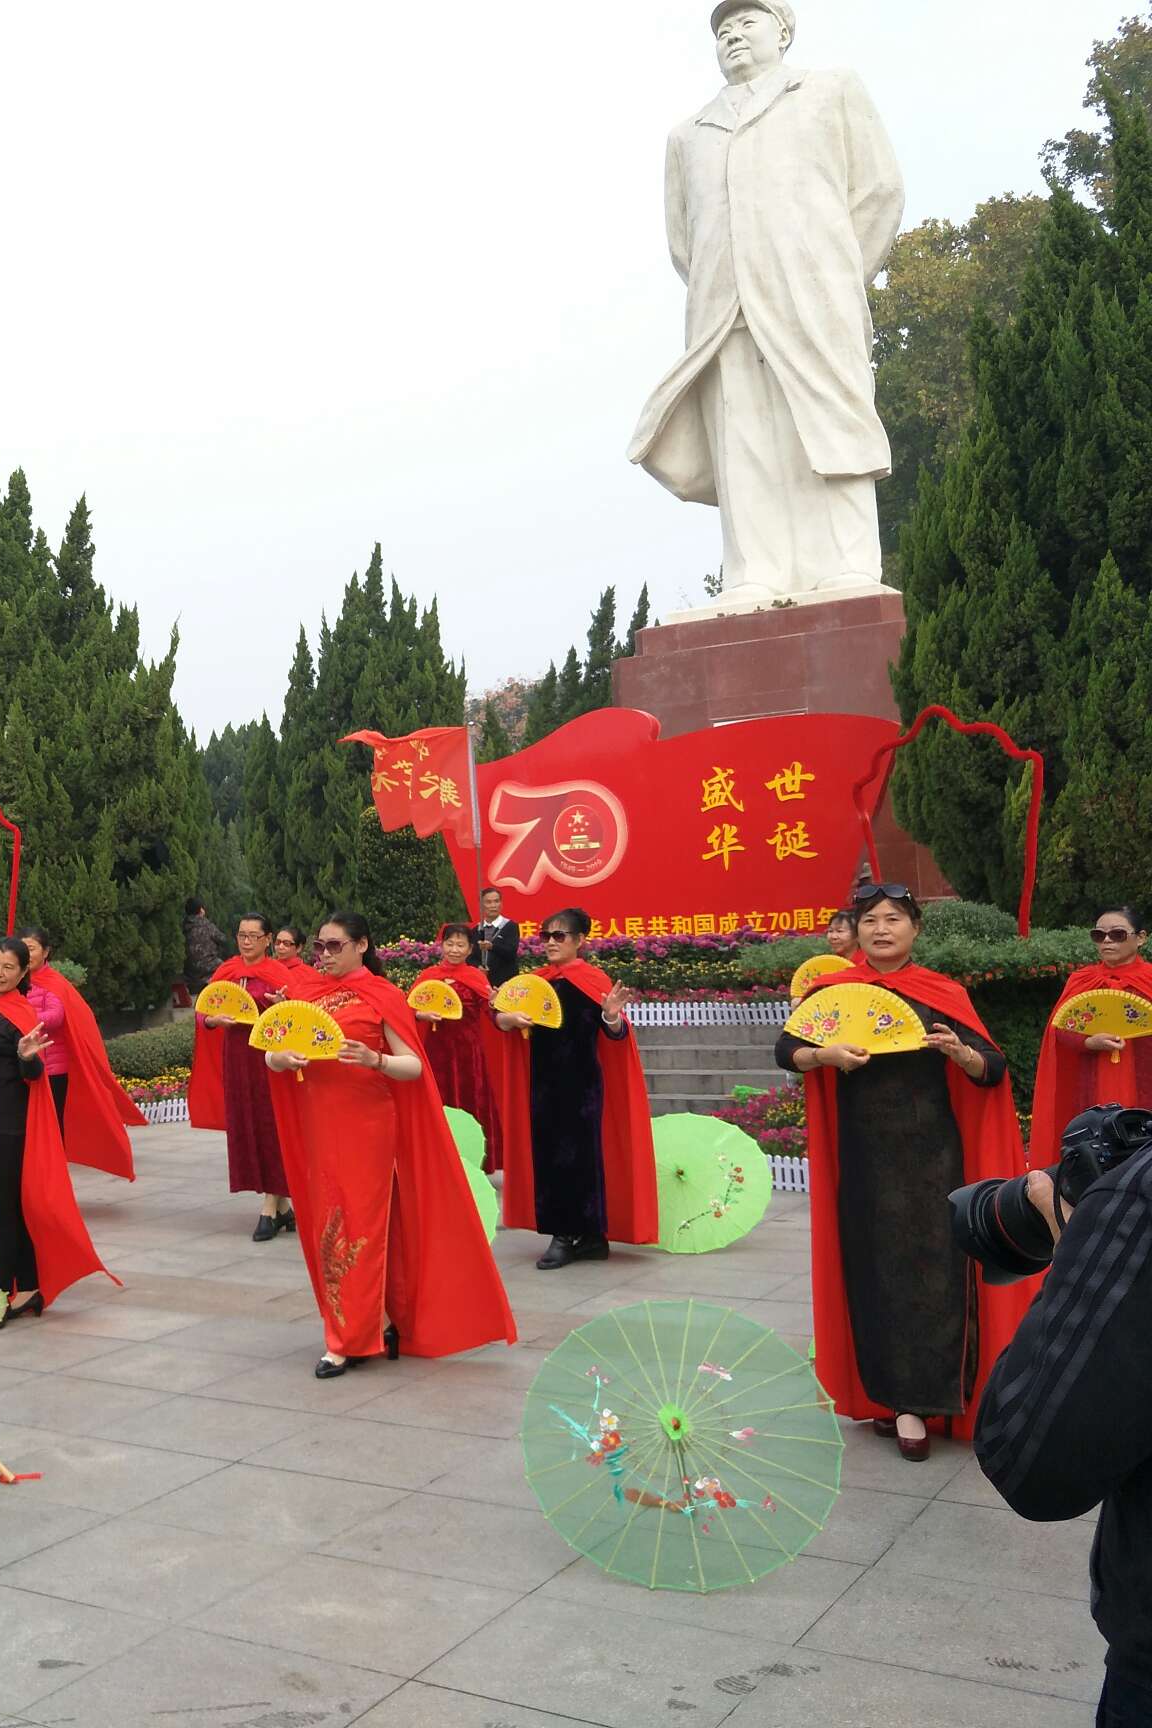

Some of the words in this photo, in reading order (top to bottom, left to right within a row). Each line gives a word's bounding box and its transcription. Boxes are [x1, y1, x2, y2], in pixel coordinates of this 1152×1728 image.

[701, 761, 815, 812] 盛世
[488, 779, 628, 895] 70
[702, 821, 818, 871] 华诞
[519, 907, 838, 940] 庆华人民共和国成立70周年
